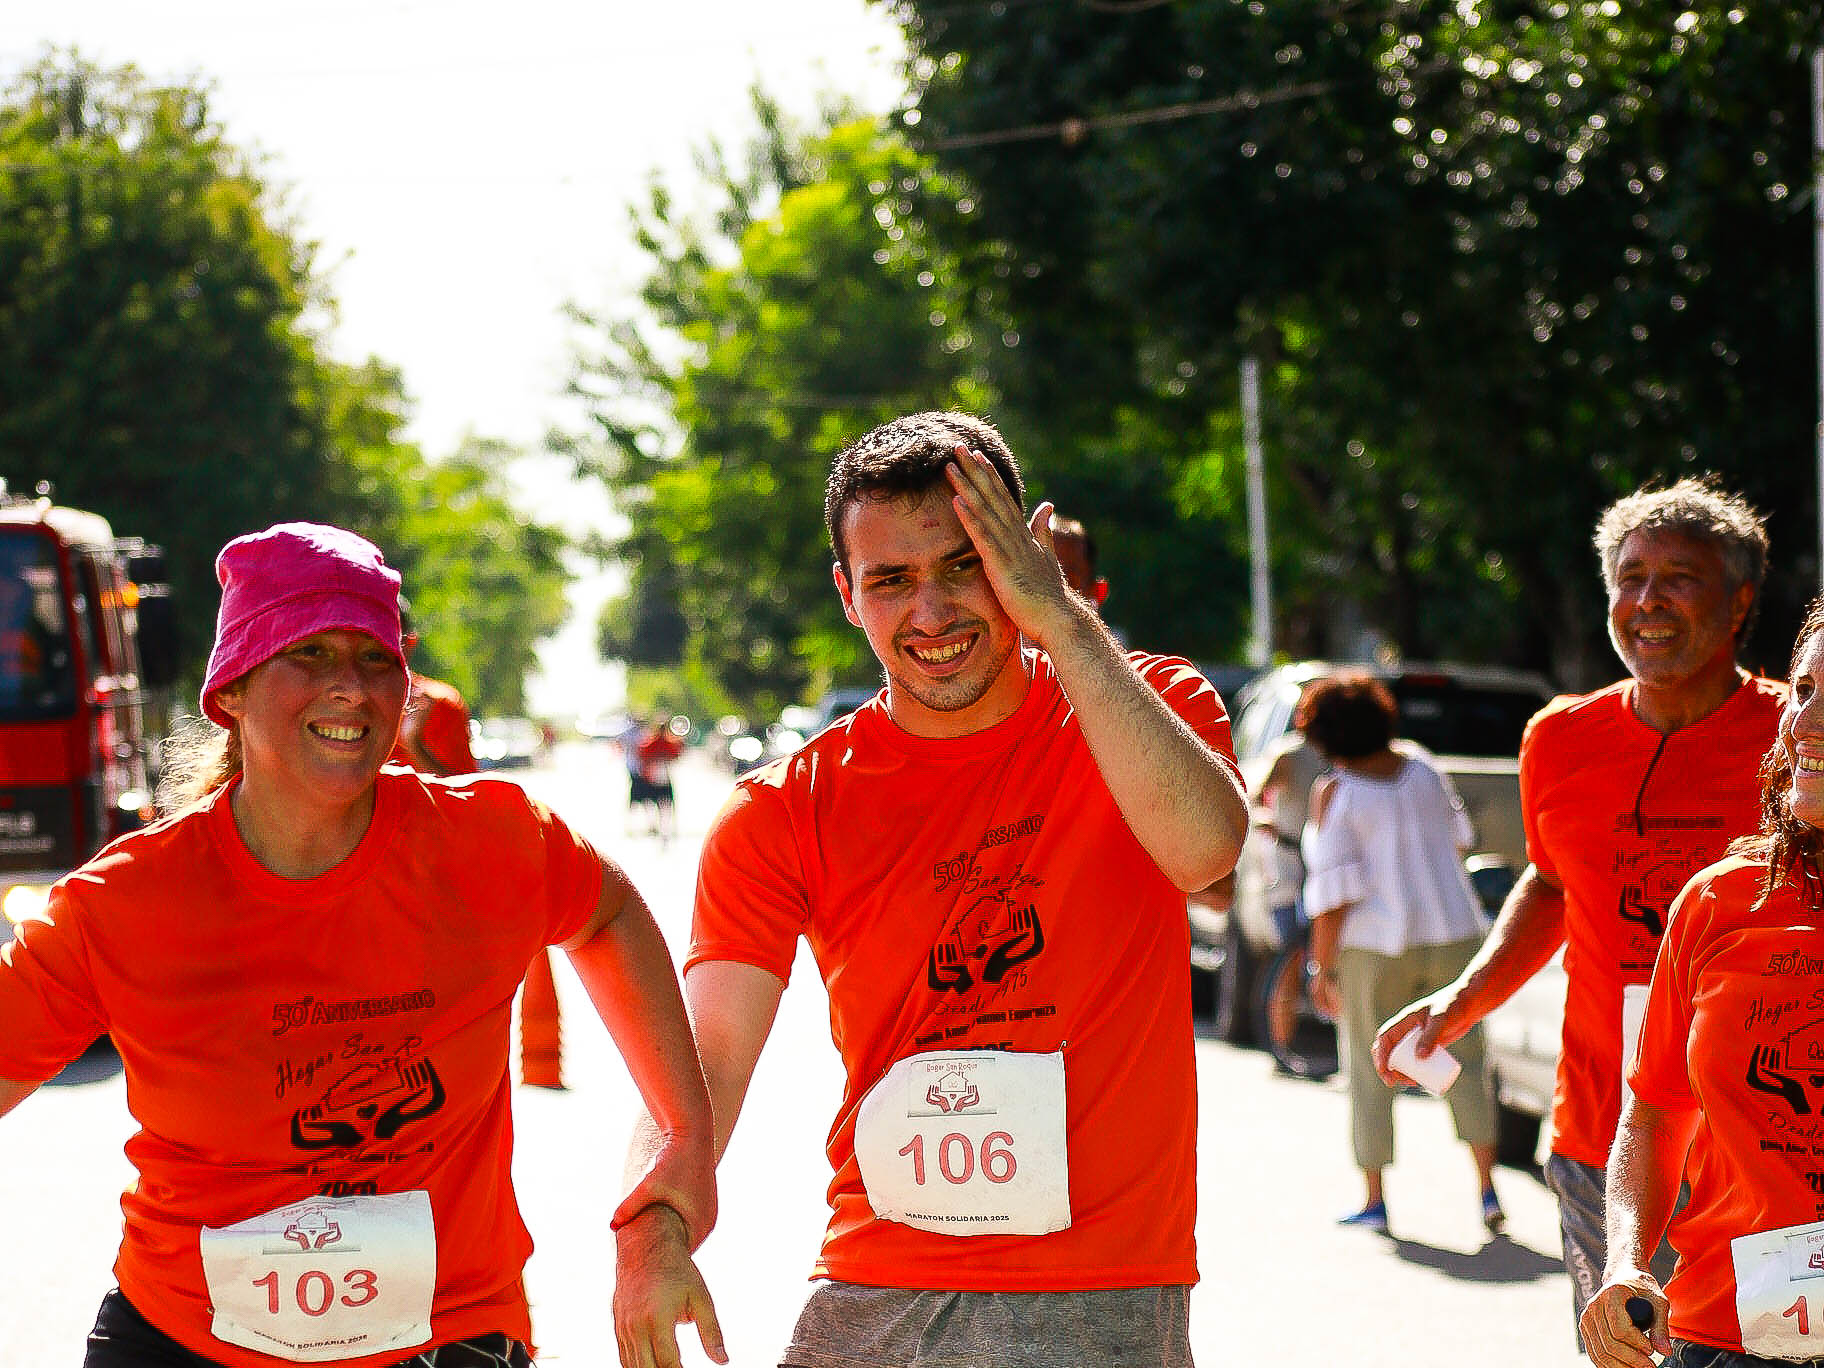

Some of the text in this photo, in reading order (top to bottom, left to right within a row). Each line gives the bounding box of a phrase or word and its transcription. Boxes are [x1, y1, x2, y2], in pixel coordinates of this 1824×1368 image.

[983, 814, 1045, 849] RSARIO
[898, 1131, 1018, 1186] 106
[905, 1211, 944, 1221] MARATON
[990, 1214, 1010, 1222] 2025
[252, 1269, 379, 1316] 103
[1782, 1295, 1824, 1336] 1
